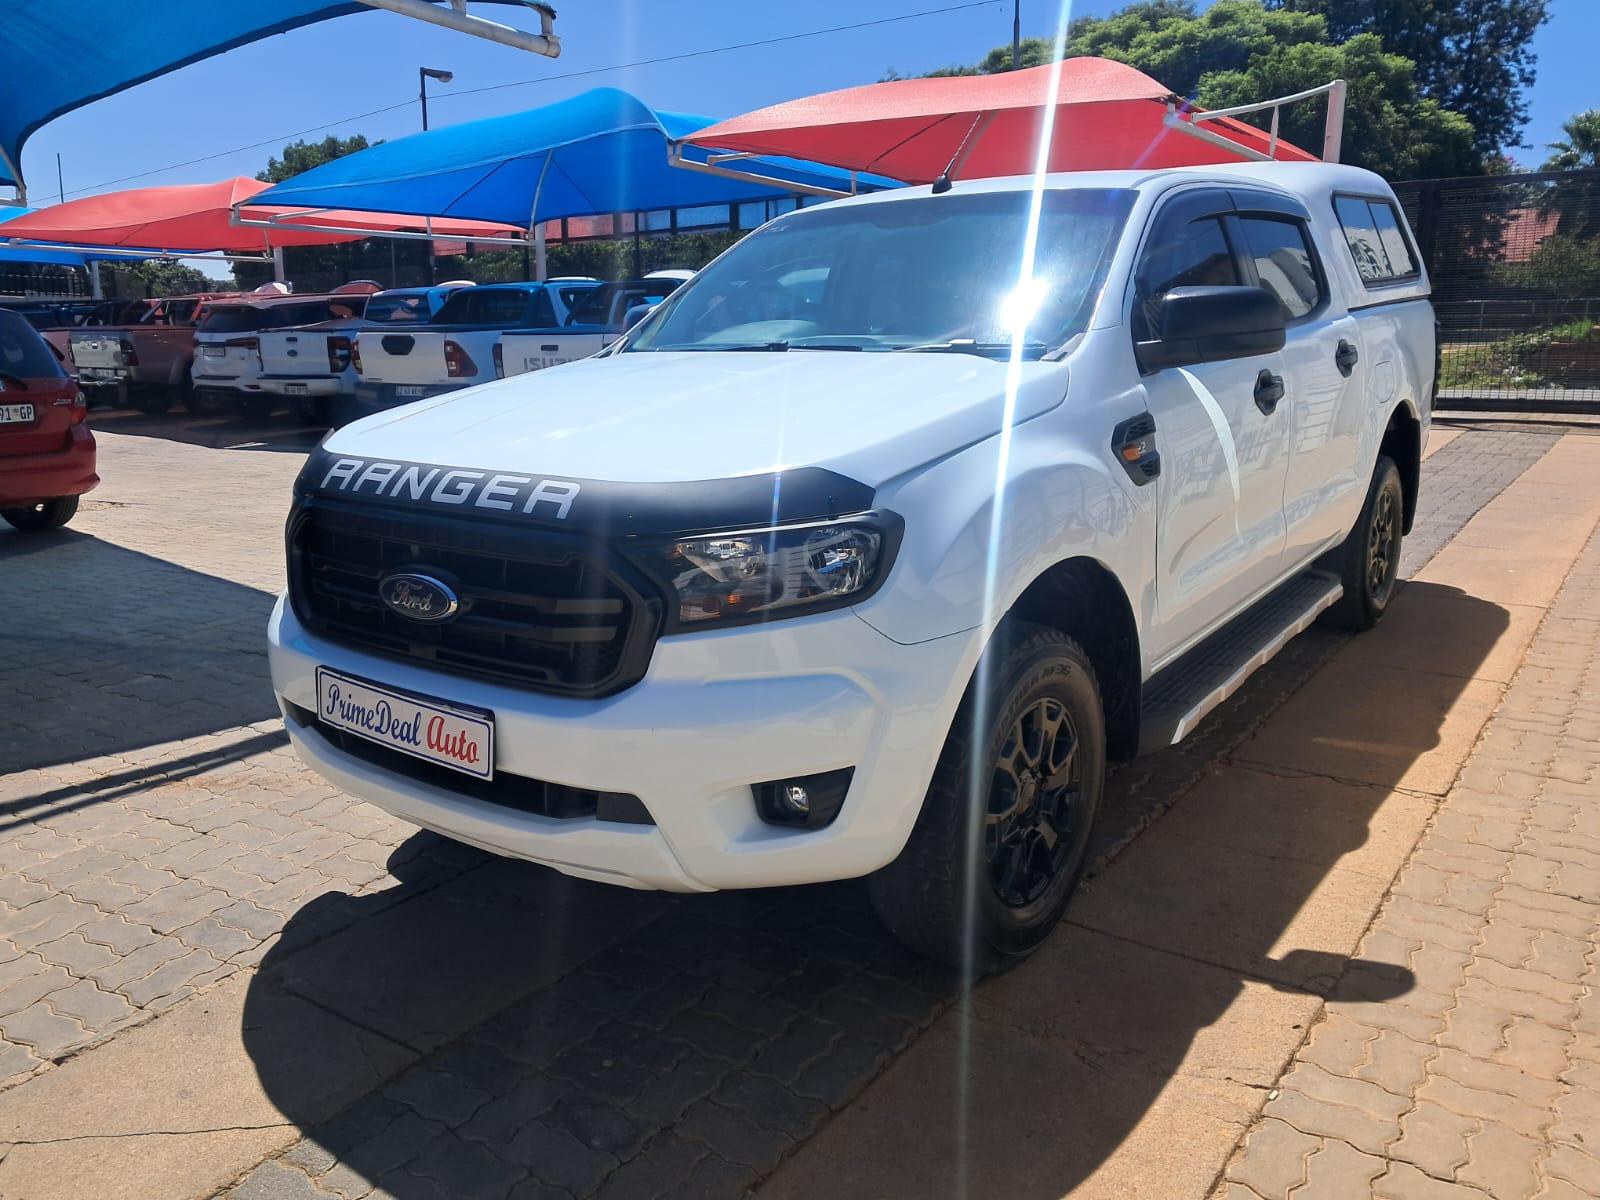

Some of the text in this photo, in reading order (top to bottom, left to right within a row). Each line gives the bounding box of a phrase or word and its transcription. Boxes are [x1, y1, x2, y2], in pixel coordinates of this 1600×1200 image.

[524, 357, 574, 371] ISU
[20, 406, 32, 420] GP
[319, 459, 582, 519] RANGER
[392, 581, 433, 611] Ford
[326, 684, 480, 764] PrimeDeal Auto
